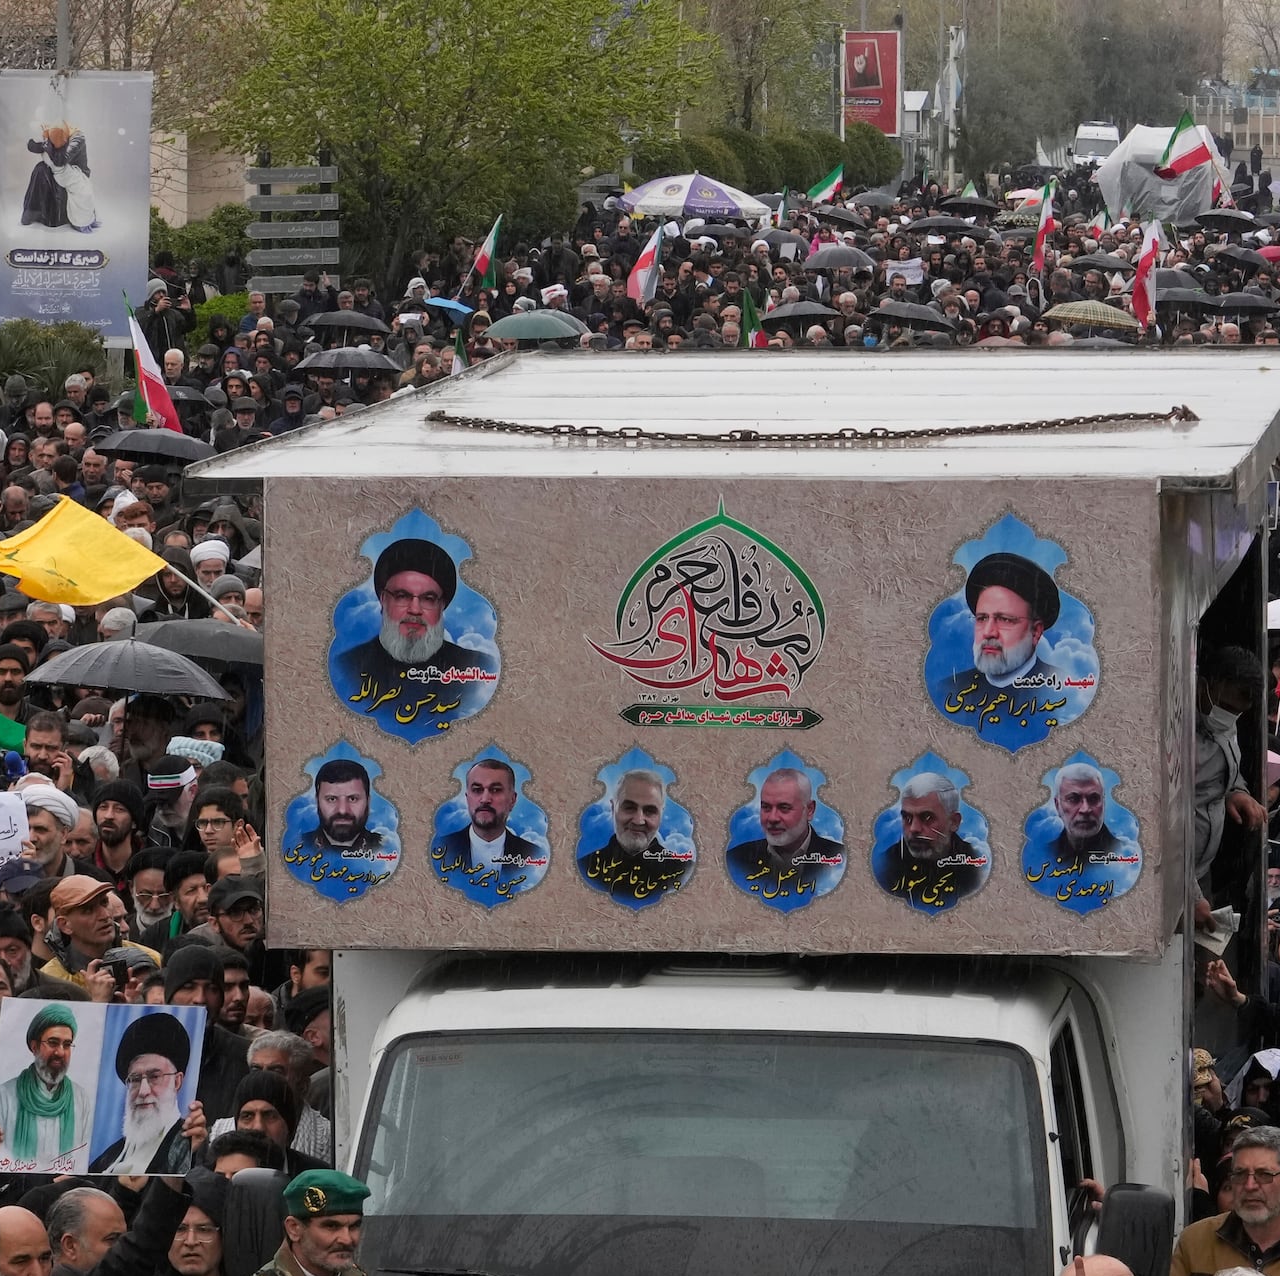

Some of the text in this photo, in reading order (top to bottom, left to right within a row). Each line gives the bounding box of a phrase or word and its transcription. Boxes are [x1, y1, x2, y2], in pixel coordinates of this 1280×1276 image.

[60, 253, 72, 263] که
[72, 252, 100, 266] صبری
[407, 666, 442, 685] مقاومت
[1013, 674, 1096, 690] شهید راه خدمت
[639, 709, 664, 723] حرم
[665, 706, 696, 723] مدافع
[697, 708, 731, 725] شهدای
[1040, 697, 1067, 726] سید
[376, 850, 398, 861] شهید
[526, 855, 547, 866] شهید
[671, 849, 694, 861] شهید
[820, 853, 842, 865] شهید
[965, 855, 987, 868] شهید
[1117, 851, 1140, 863] شهید
